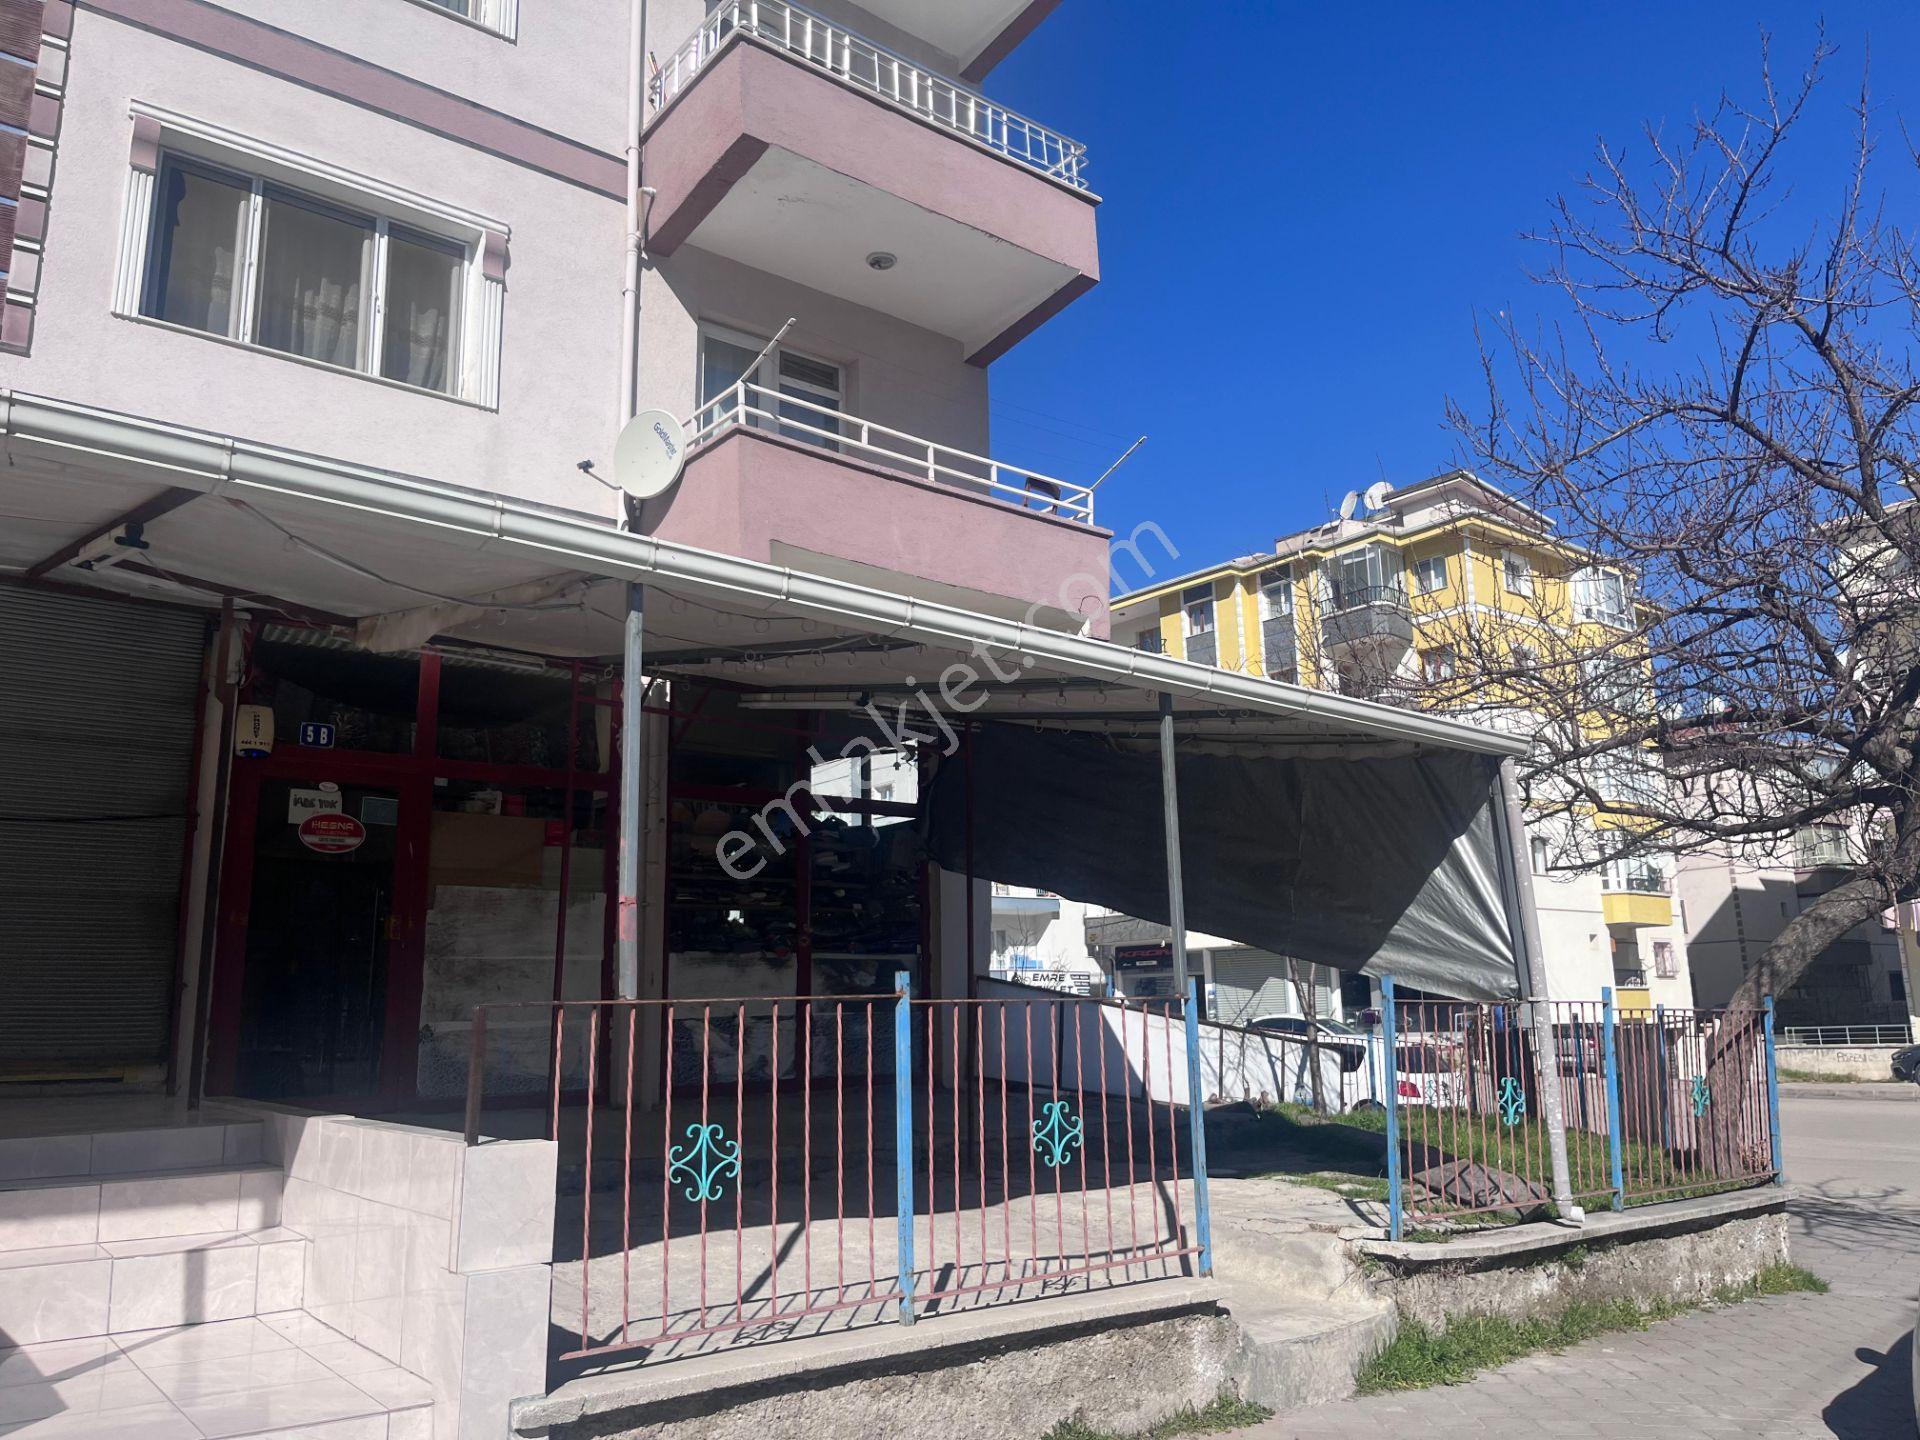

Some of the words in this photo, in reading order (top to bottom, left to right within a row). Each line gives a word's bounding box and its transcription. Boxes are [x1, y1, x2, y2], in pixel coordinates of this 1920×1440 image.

[306, 725, 314, 743] 5
[319, 727, 328, 744] B
[312, 820, 354, 831] HESNA
[1032, 973, 1065, 982] EMRE
